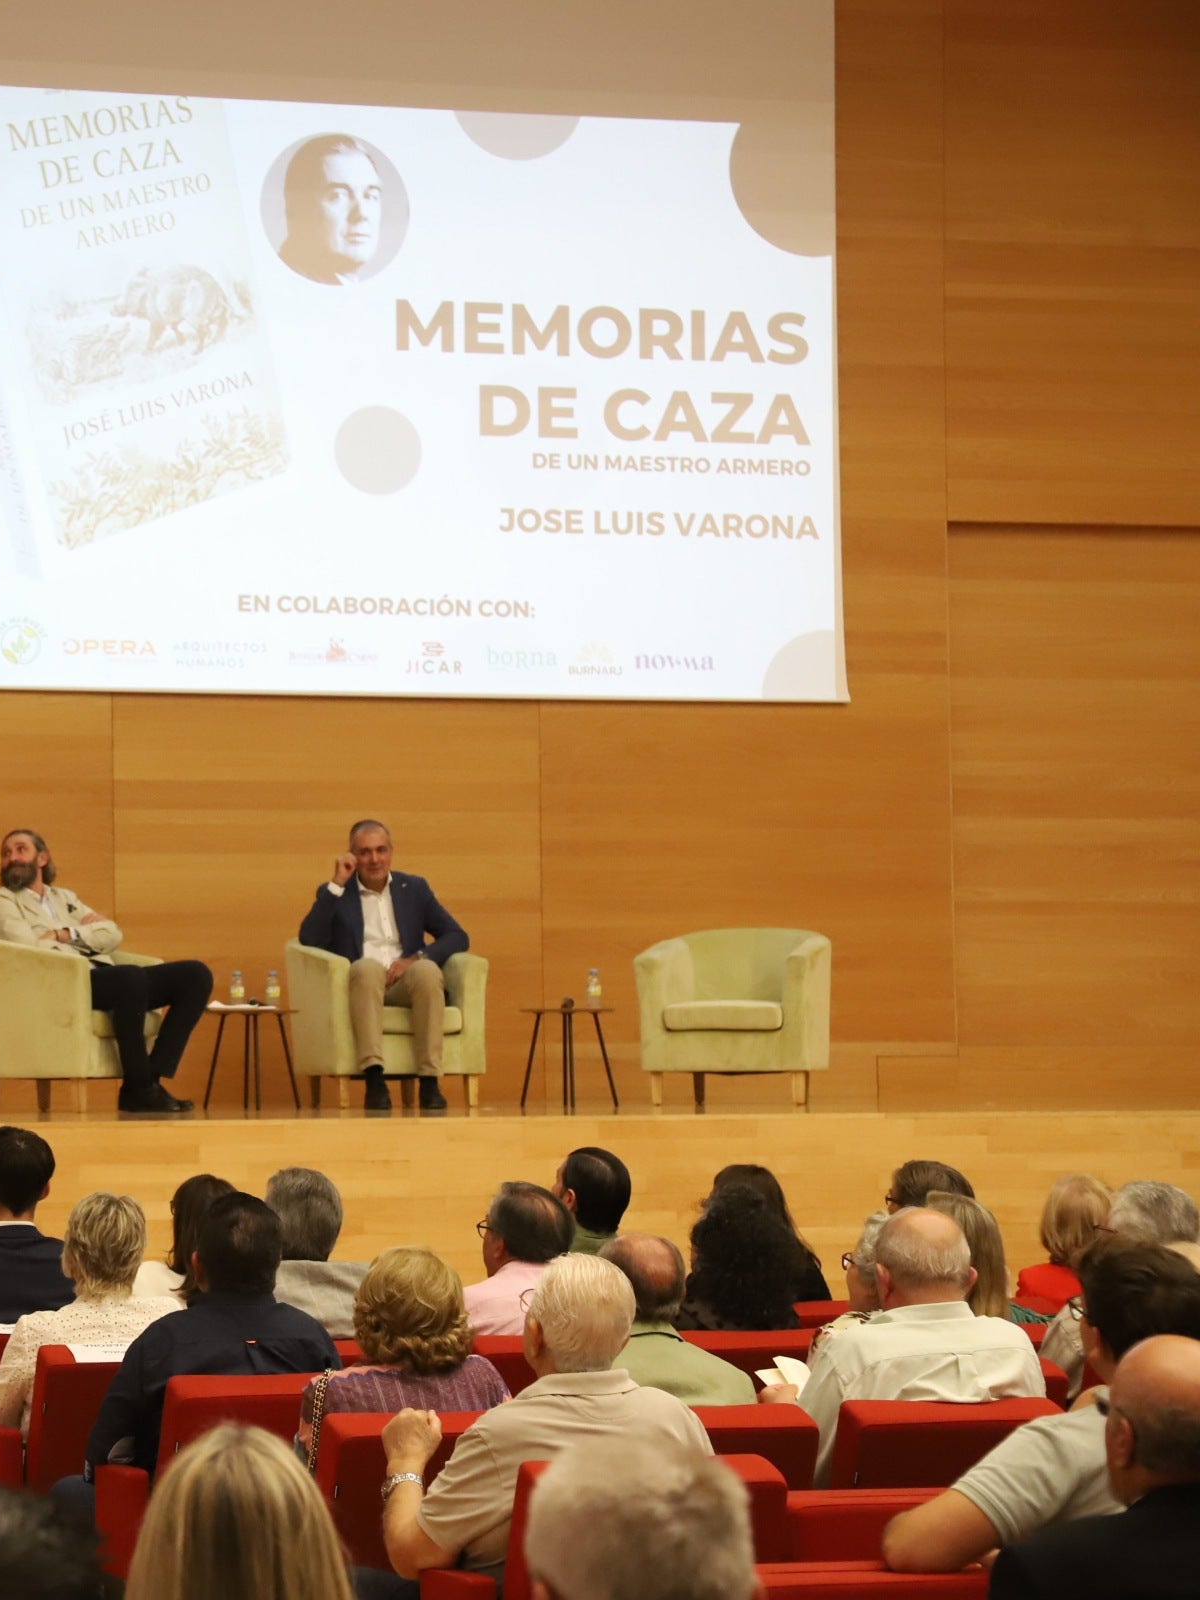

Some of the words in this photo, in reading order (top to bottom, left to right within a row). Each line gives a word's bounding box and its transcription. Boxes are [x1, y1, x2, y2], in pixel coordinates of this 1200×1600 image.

[6, 96, 193, 152] MEMORIAS
[38, 155, 84, 189] DE
[92, 138, 183, 179] CAZA
[19, 204, 53, 229] DE
[58, 195, 96, 221] UN
[102, 172, 212, 213] MAESTRO
[75, 210, 177, 250] ARMERO
[395, 299, 810, 366] MEMORIAS
[118, 397, 167, 427] LUIS
[170, 371, 254, 408] VARONA
[478, 384, 579, 439] DE
[603, 388, 812, 446] CAZA
[531, 452, 561, 470] DE
[567, 454, 598, 471] UN
[604, 455, 711, 474] MAESTRO
[716, 458, 811, 477] ARMERO
[499, 508, 584, 535] JOSE
[593, 510, 665, 537] LUIS
[674, 512, 820, 541] VARONA
[237, 594, 270, 613] EN
[277, 594, 472, 617] COLABORACIÓN
[478, 599, 536, 619] CON:
[405, 660, 463, 675] JICAR
